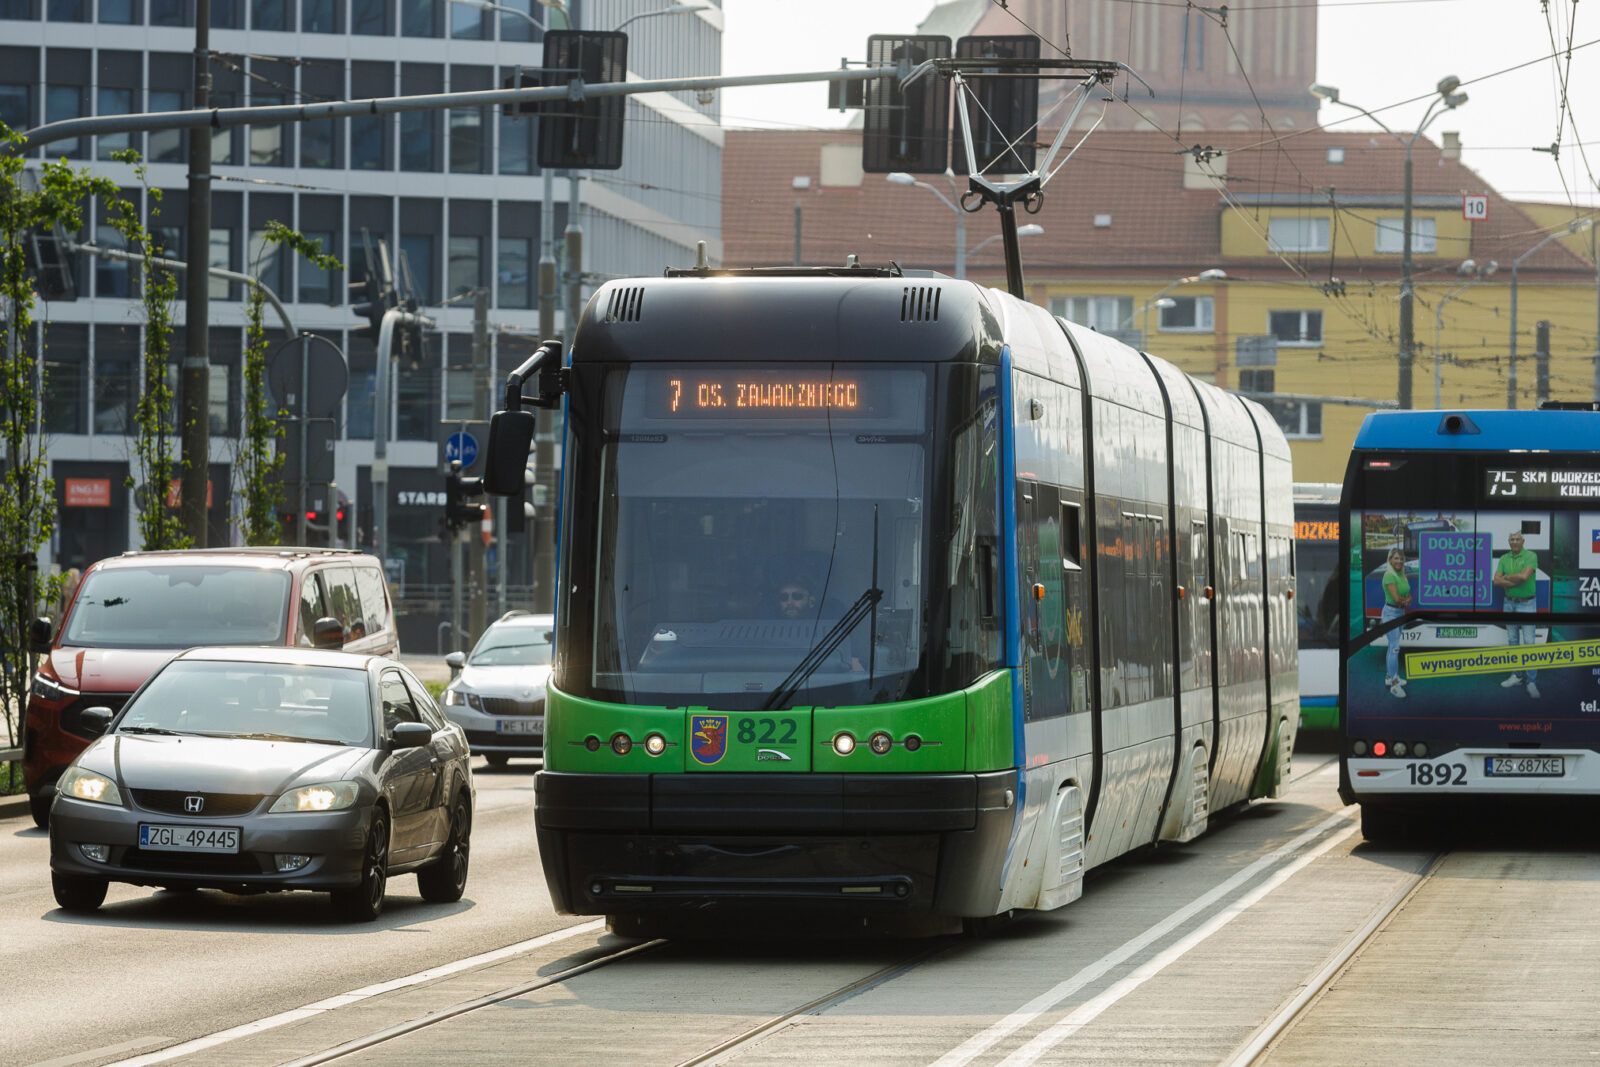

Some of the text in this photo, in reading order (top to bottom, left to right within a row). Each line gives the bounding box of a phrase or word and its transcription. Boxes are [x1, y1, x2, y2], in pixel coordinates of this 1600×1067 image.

[1467, 201, 1484, 215] 10
[670, 380, 857, 412] 7 OS. ZAWADZKIEGO
[1487, 470, 1517, 495] 75
[1522, 471, 1547, 483] SKM
[1560, 484, 1600, 497] KOLUM
[1428, 537, 1484, 553] DOŁĄCZ
[1446, 553, 1466, 566] DO
[1428, 569, 1484, 582] NASZEJ
[1423, 585, 1474, 598] ZAŁOGI
[1401, 632, 1421, 641] 1197
[1420, 652, 1518, 673] wynagrodzenie
[1521, 646, 1575, 665] powyżej
[1580, 700, 1600, 713] tel.
[737, 718, 797, 744] 822
[1498, 722, 1552, 733] www.spak.pl
[1495, 760, 1513, 773] ZS
[1518, 760, 1559, 773] 687KE
[1406, 763, 1467, 785] 1892
[149, 828, 236, 848] ZGL 49445
